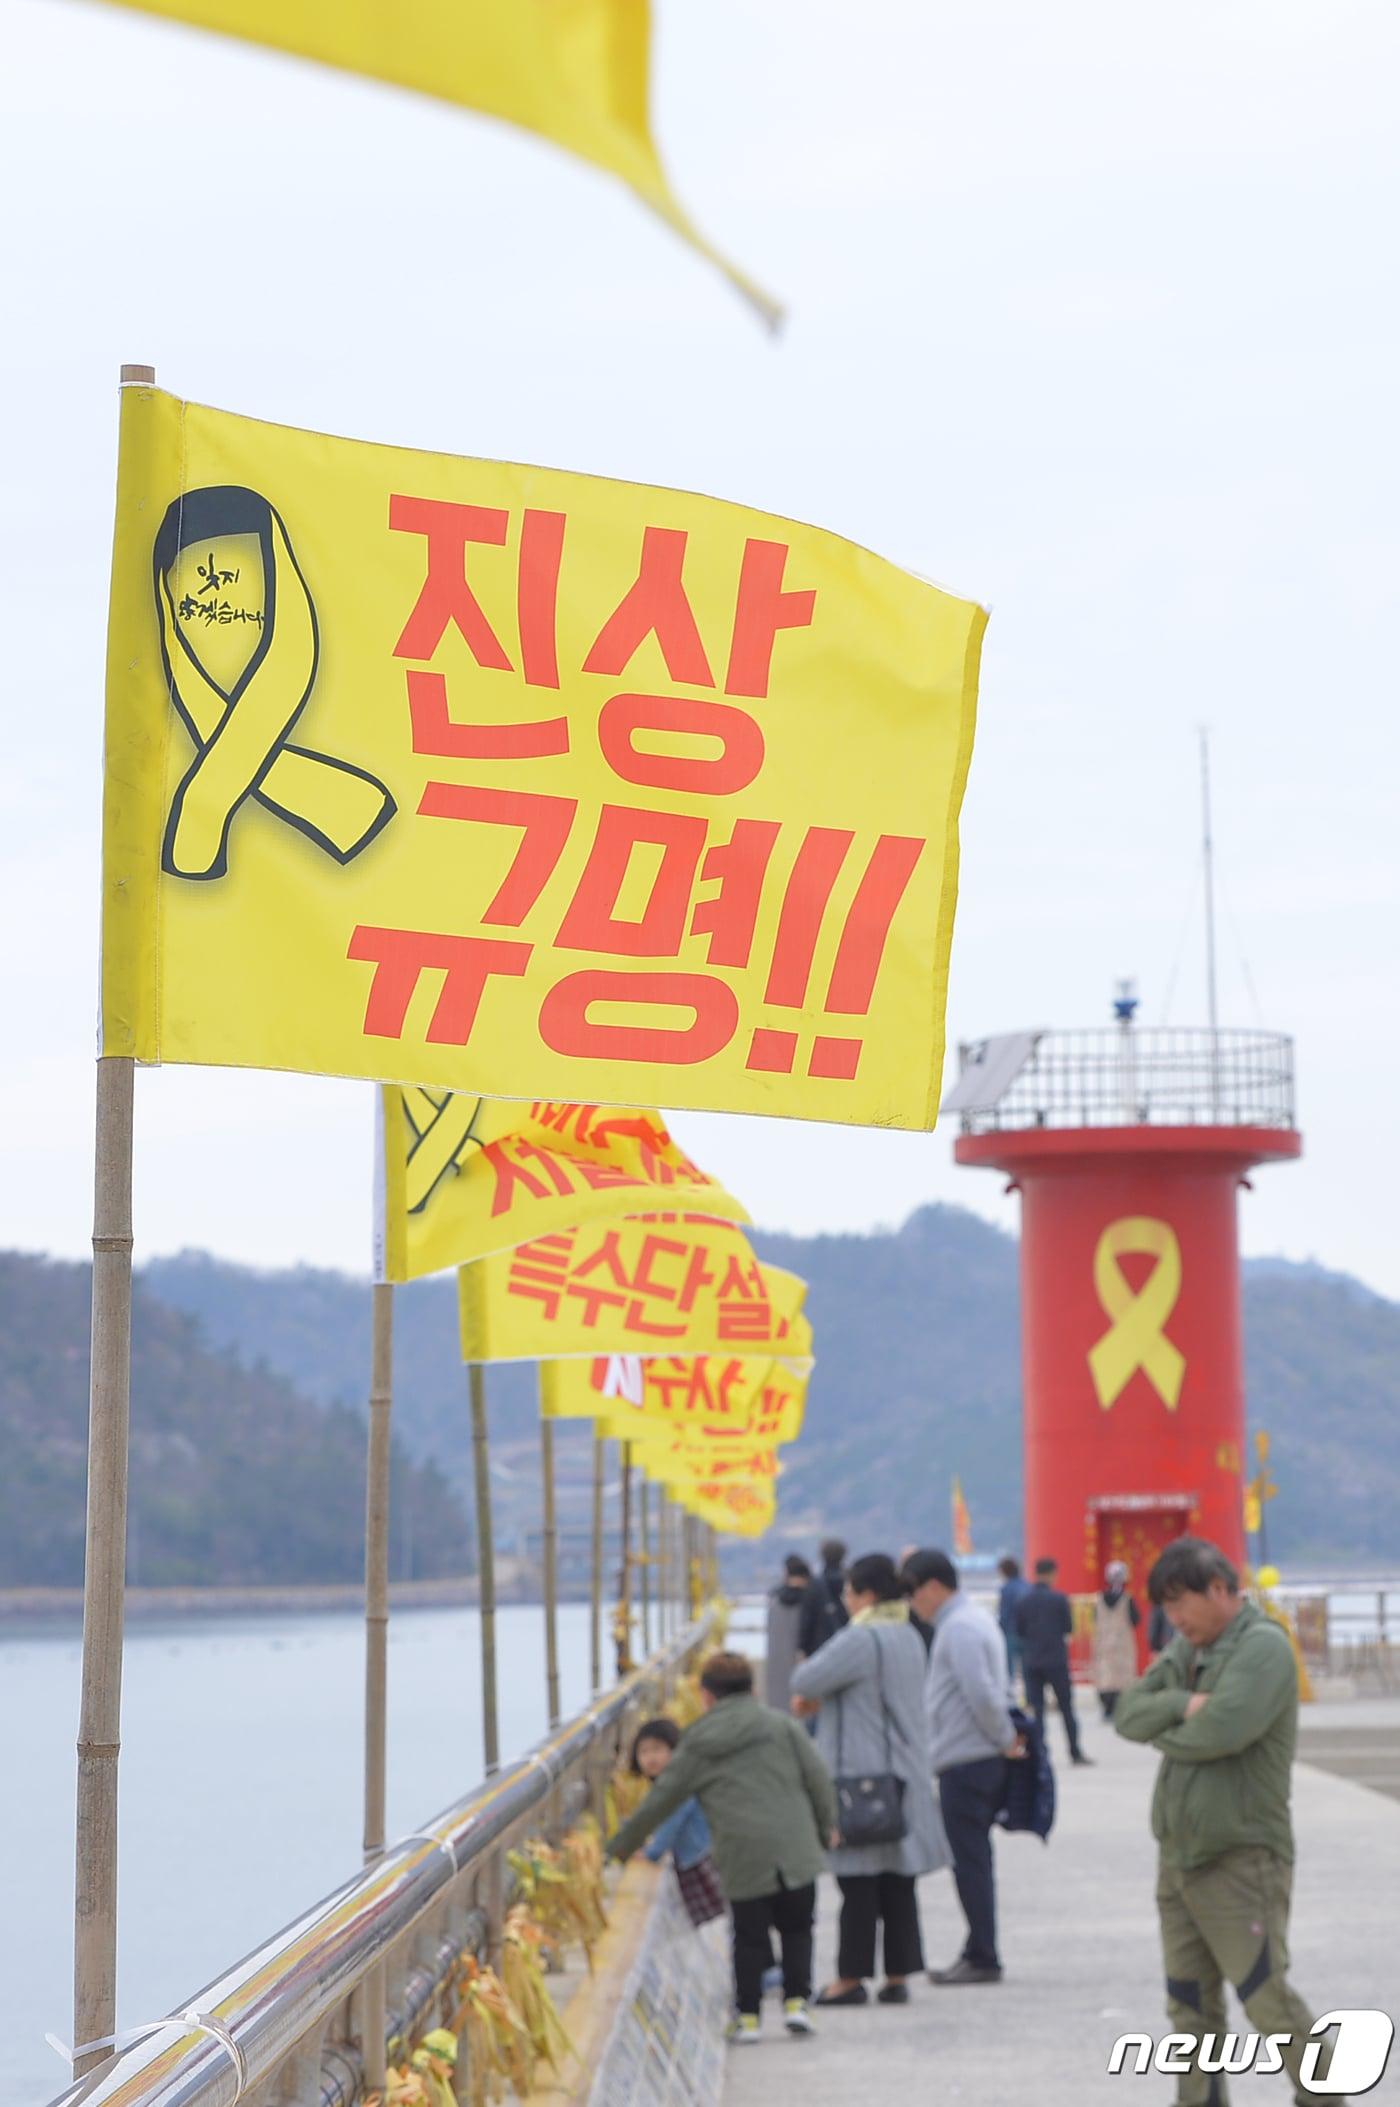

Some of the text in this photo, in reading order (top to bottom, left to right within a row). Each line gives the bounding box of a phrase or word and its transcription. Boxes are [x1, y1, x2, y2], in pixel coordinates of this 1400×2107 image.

[179, 592, 264, 630] 않겠습니다
[197, 552, 240, 595] 잊지
[388, 493, 816, 796] 진상
[347, 780, 927, 1080] 규명!!
